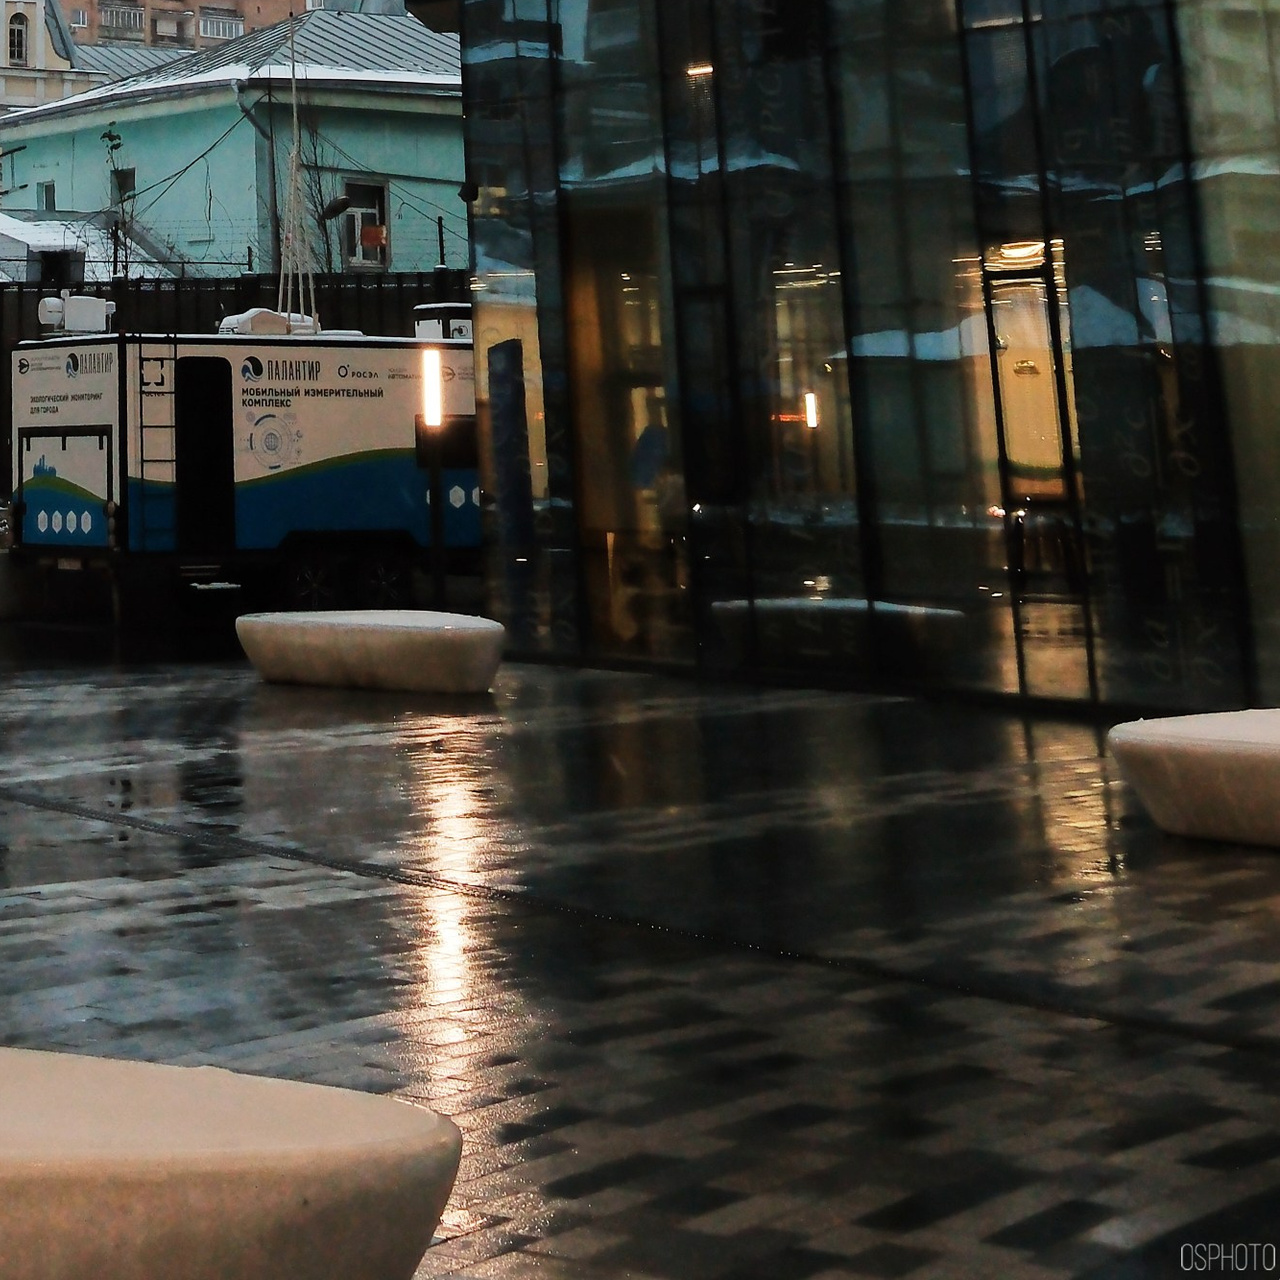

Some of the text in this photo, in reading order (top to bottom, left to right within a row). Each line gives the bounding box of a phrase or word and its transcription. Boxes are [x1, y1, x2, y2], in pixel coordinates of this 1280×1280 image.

[80, 352, 113, 374] ПАЛАНТИР
[267, 360, 321, 381] ПАЛАНТИР
[352, 371, 379, 379] РОСЭЛ
[242, 386, 384, 398] МОБИЛЬНЫЙ ИЗМЕРИТЕЛЬНЫЙ
[242, 398, 292, 408] КОМПЛЕКС
